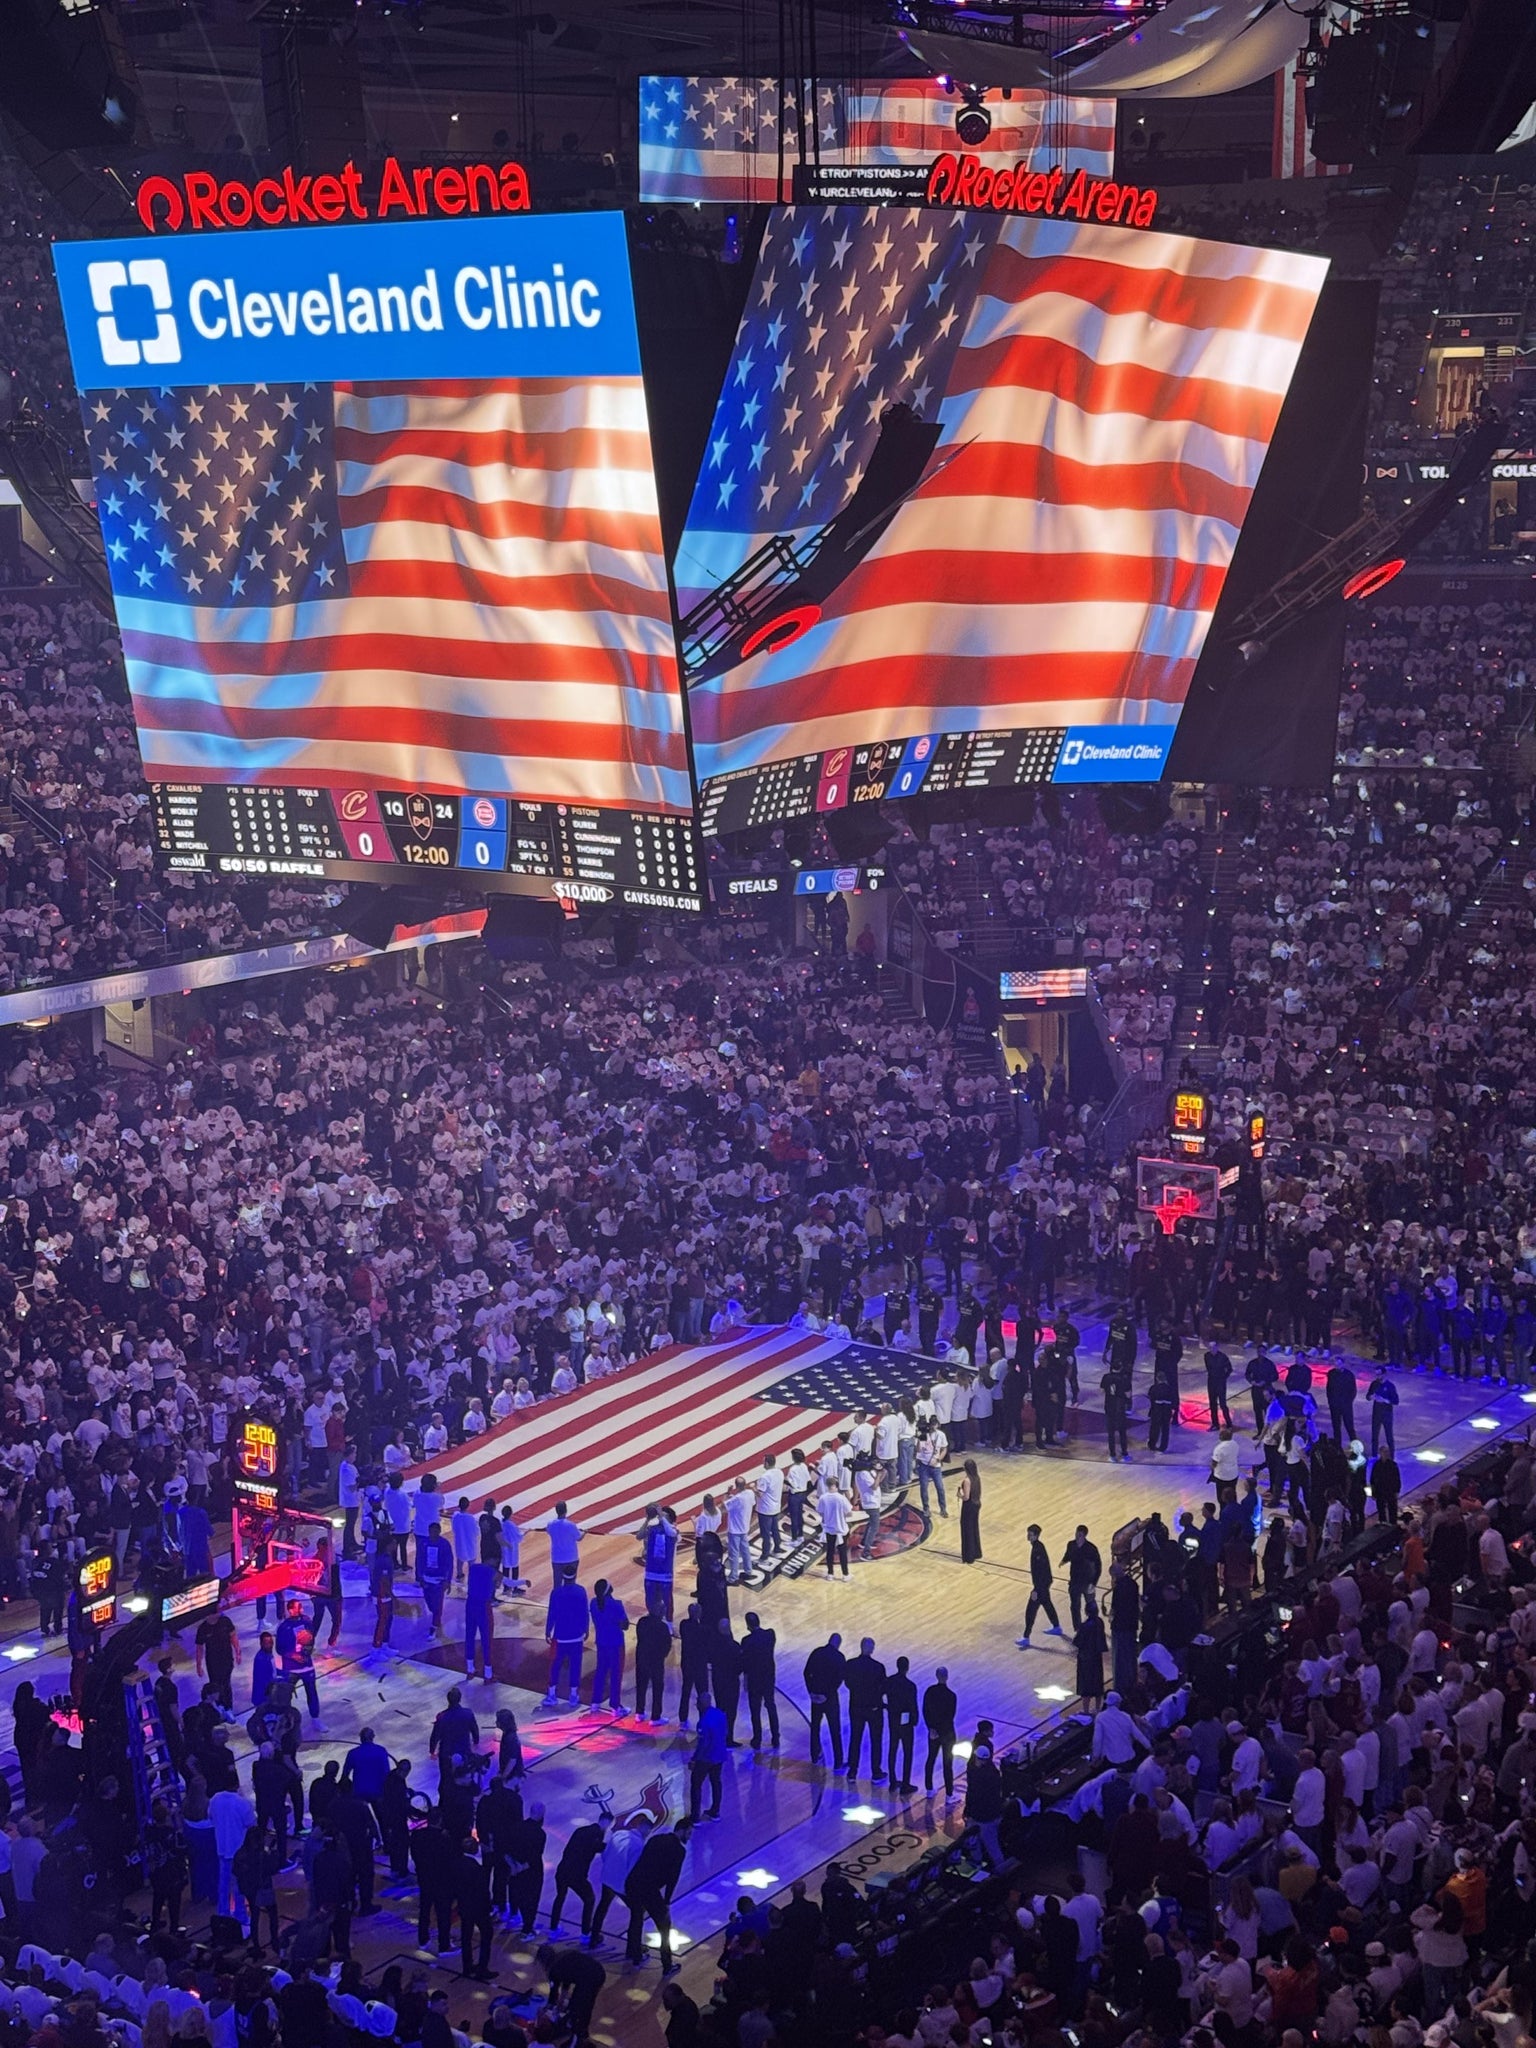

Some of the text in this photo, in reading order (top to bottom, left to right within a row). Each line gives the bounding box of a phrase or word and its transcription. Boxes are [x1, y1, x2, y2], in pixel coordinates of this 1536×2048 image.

[858, 168, 901, 178] PISTONS
[184, 157, 531, 229] Rocket Arena
[952, 154, 1158, 227] Rocket Arena
[190, 264, 601, 338] Cleveland Clinic
[856, 752, 868, 764] 1Q
[888, 746, 902, 758] 24
[1082, 744, 1162, 760] Cleveland Clinic
[166, 784, 203, 793] CAVALIERS
[901, 772, 912, 791] 0
[297, 789, 319, 797] FOULS
[826, 784, 838, 804] 0
[854, 782, 885, 802] 12:00
[229, 798, 236, 806] 0
[246, 798, 253, 807] 0
[262, 799, 268, 808] 0
[277, 800, 284, 808] 0
[306, 797, 313, 807] 0
[384, 801, 404, 816] 1Q
[519, 802, 542, 812] FOULS
[157, 807, 164, 815] 4
[231, 809, 238, 818] 0
[248, 810, 254, 818] 0
[263, 810, 270, 819] 0
[279, 811, 286, 820] 0
[435, 804, 453, 819] 24
[528, 811, 535, 821] 0
[571, 807, 600, 817] PISTONS
[631, 814, 643, 822] PTS
[233, 820, 240, 829] 0
[250, 821, 256, 830] 0
[265, 822, 272, 831] 0
[281, 823, 288, 832] 0
[322, 825, 328, 834] 0
[634, 826, 641, 835] 0
[652, 828, 659, 837] 0
[666, 829, 674, 838] 0
[684, 831, 691, 840] 0
[158, 830, 170, 838] 32
[235, 832, 242, 840] 0
[252, 832, 258, 841] 0
[267, 834, 274, 842] 0
[283, 834, 290, 843] 0
[324, 837, 330, 845] 0
[358, 832, 373, 856] 0
[561, 831, 567, 840] 2
[636, 838, 643, 847] 0
[654, 840, 661, 849] 0
[668, 842, 675, 851] 0
[686, 844, 692, 853] 0
[160, 841, 171, 849] 45
[236, 843, 244, 852] 0
[253, 844, 260, 853] 0
[268, 845, 276, 854] 0
[284, 846, 292, 854] 0
[476, 841, 490, 865] 0
[540, 841, 547, 850] 0
[170, 853, 206, 866] oswald
[403, 844, 450, 865] 12:00
[542, 854, 549, 862] 0
[562, 843, 569, 852] 9
[637, 850, 644, 860] 0
[655, 852, 662, 862] 0
[670, 854, 677, 864] 0
[687, 856, 694, 866] 0
[269, 861, 325, 875] RAFFLE
[562, 855, 571, 864] 12
[639, 863, 646, 872] 0
[657, 865, 664, 874] 0
[671, 867, 678, 876] 0
[688, 869, 695, 878] 0
[867, 869, 885, 877] FG%
[563, 867, 574, 876] 55
[640, 876, 647, 885] 0
[658, 878, 666, 887] 0
[672, 880, 679, 889] 0
[690, 882, 697, 891] 0
[729, 879, 778, 894] STEALS
[805, 876, 815, 890] 0
[870, 879, 878, 890] 0
[554, 882, 607, 902] $10,000
[623, 890, 701, 911] CAVS5050.COM
[39, 986, 90, 1011] TODAY'S
[1177, 1094, 1203, 1110] 12:00
[1175, 1107, 1201, 1129] 24
[245, 1423, 276, 1446] 12:00
[244, 1440, 274, 1474] 24
[247, 1482, 278, 1497] TISSOT
[87, 1573, 106, 1594] 24
[838, 1834, 923, 1881] Googl
